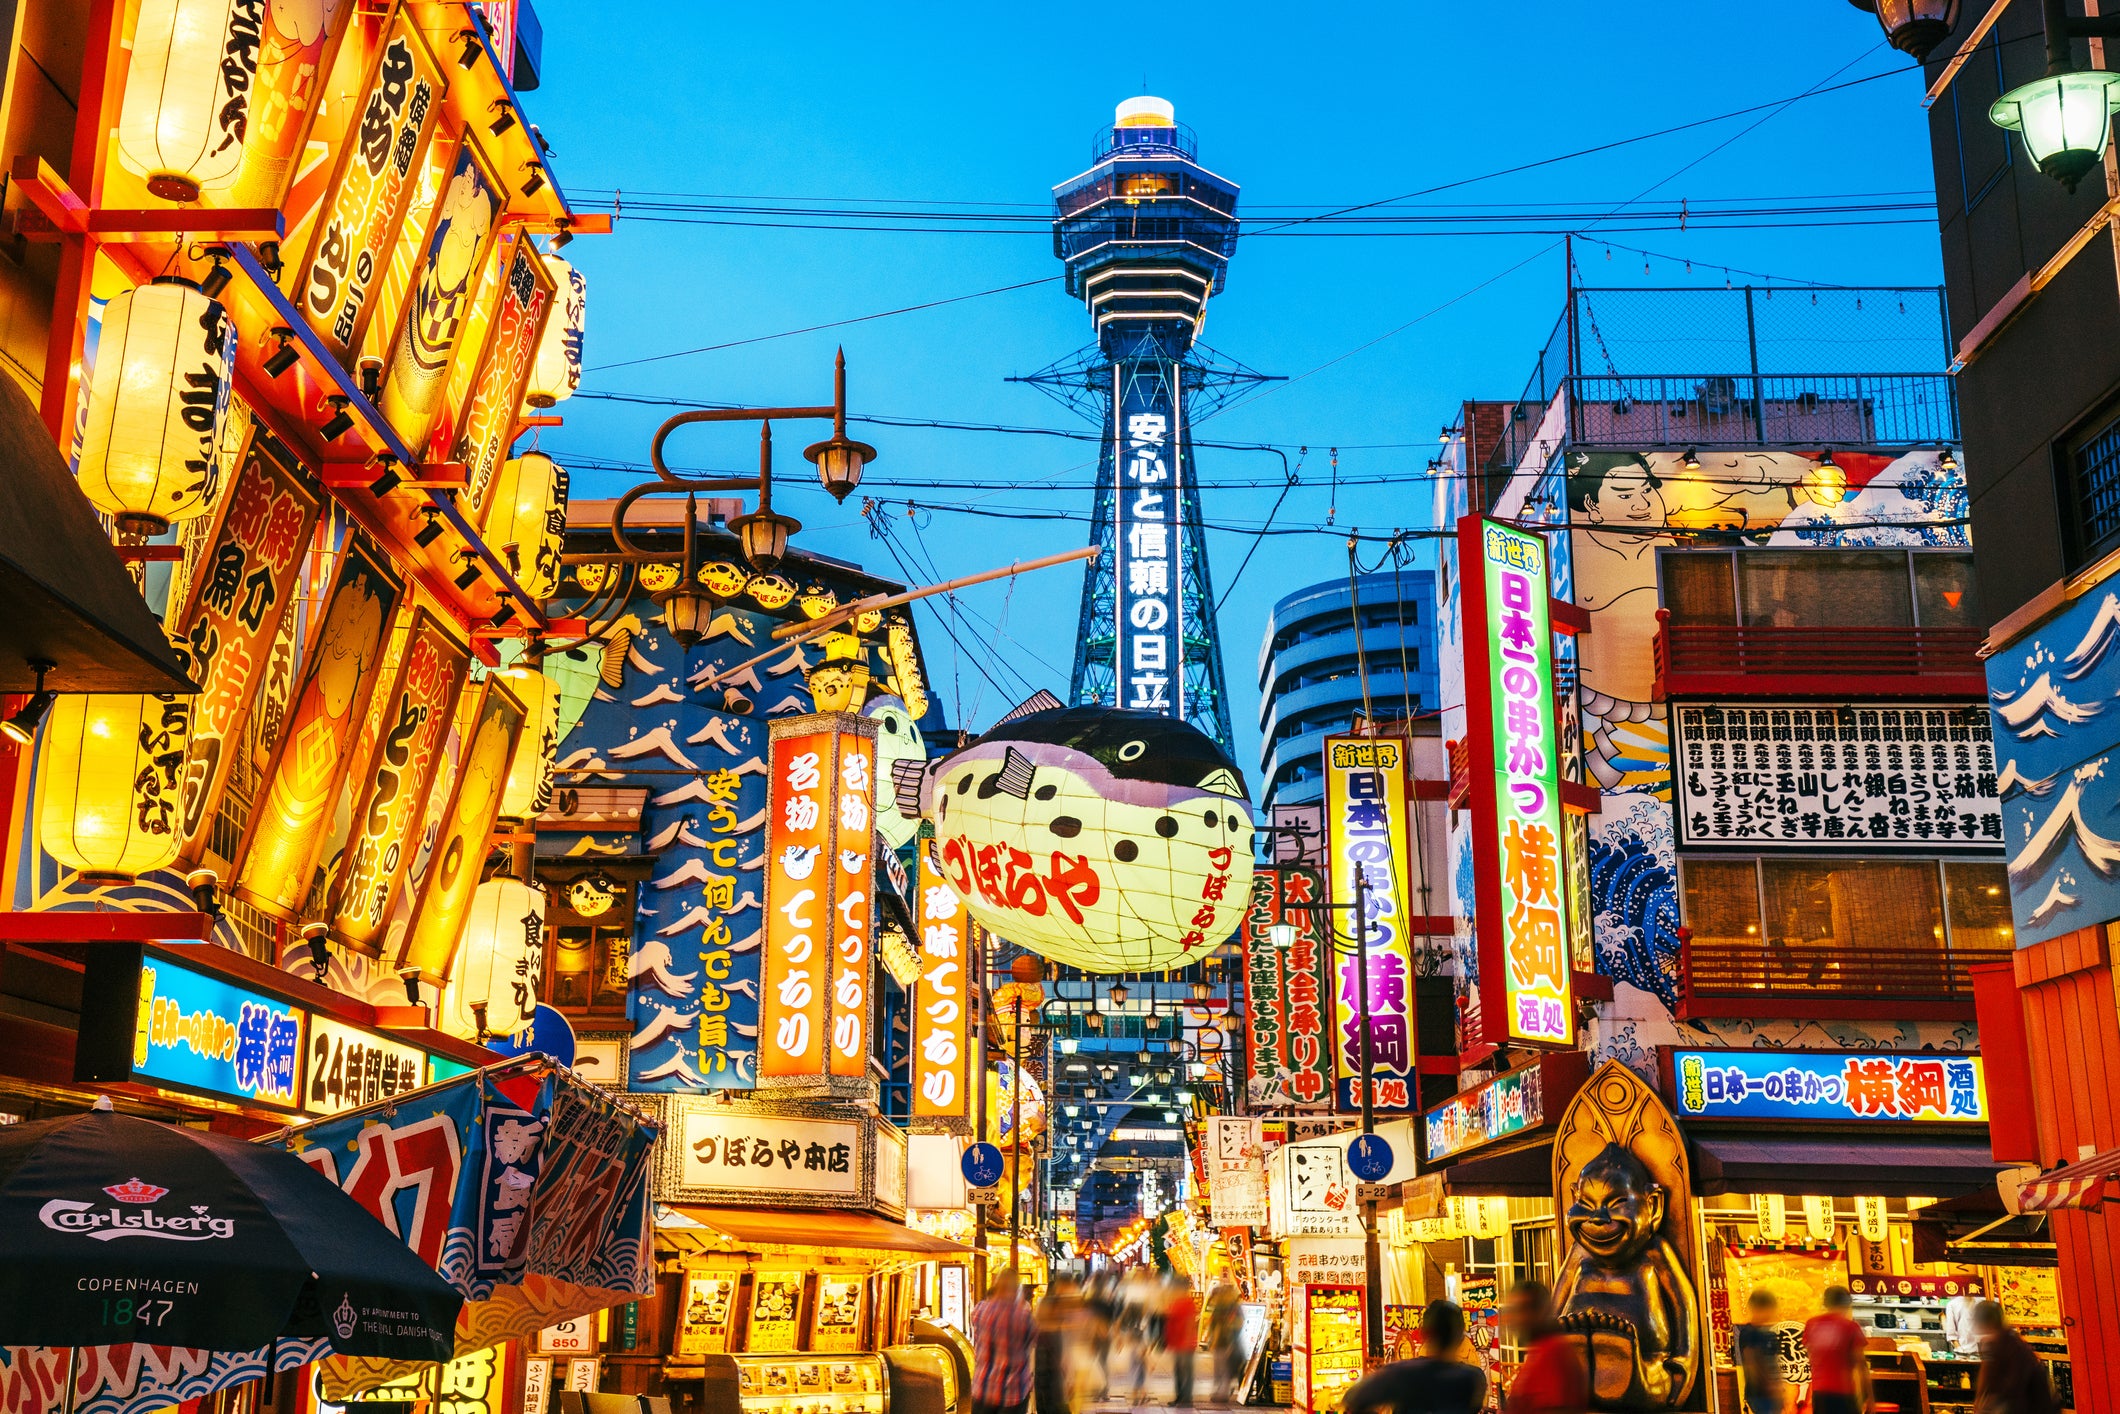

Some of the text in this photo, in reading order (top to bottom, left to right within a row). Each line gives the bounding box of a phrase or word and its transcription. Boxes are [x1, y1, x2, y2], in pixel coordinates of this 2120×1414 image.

[311, 40, 414, 315] 名物串かつ
[1128, 413, 1169, 708] 安心と信頼の日立
[1487, 531, 1541, 573] 新世界
[1334, 744, 1398, 768] 新世界
[1684, 710, 1704, 742] 前頭
[1728, 710, 1748, 742] 前頭
[1750, 710, 1770, 742] 前頭
[1772, 710, 1792, 742] 前頭
[1794, 710, 1814, 742] 前頭
[1816, 710, 1836, 742] 前頭
[1859, 710, 1881, 742] 前頭
[1882, 710, 1903, 742] 前頭
[1904, 710, 1925, 742] 前頭
[1926, 710, 1948, 742] 前頭
[370, 660, 455, 928] 大阪下町の味
[1688, 772, 1710, 838] もち
[1710, 772, 1734, 838] うずら玉子
[1731, 772, 1756, 838] 紅しょうが
[1754, 772, 1776, 838] にんにく
[1776, 772, 1800, 838] 玉ねぎ
[1798, 772, 1822, 838] 山芋
[1820, 772, 1845, 838] しし唐
[1843, 772, 1867, 838] れんこん
[1864, 772, 1889, 838] 銀杏
[1888, 772, 1912, 838] 白ねぎ
[1910, 772, 1934, 838] さつま芋
[1933, 772, 1957, 838] じゃが芋
[1955, 772, 1980, 838] 茄子
[1976, 772, 2000, 838] 椎茸
[776, 752, 820, 1058] 名物 てっちり
[834, 752, 869, 1058] 名物 てっちり
[943, 834, 1101, 925] づぼらや
[1179, 844, 1235, 953] づぼらや
[1505, 823, 1563, 989] 横綱
[699, 768, 742, 1074] 安うて何んでも旨い
[922, 887, 960, 1107] 珍味てっちり
[1342, 953, 1408, 1074] 横綱
[1520, 999, 1563, 1035] 酒処
[236, 1003, 297, 1099] 横綱
[1684, 1059, 1977, 1115] 新世界 日本一の串かつ 横綱 酒処
[693, 1135, 850, 1173] づぼらや本店
[39, 1199, 235, 1241] Carlsberg
[489, 1119, 544, 1258] 新食感
[77, 1277, 199, 1294] COPENHAGEN
[103, 1299, 174, 1327] 1847
[411, 1312, 420, 1321] TO
[363, 1321, 378, 1333] THE
[397, 1325, 428, 1337] DANISH
[552, 1338, 579, 1348] 850
